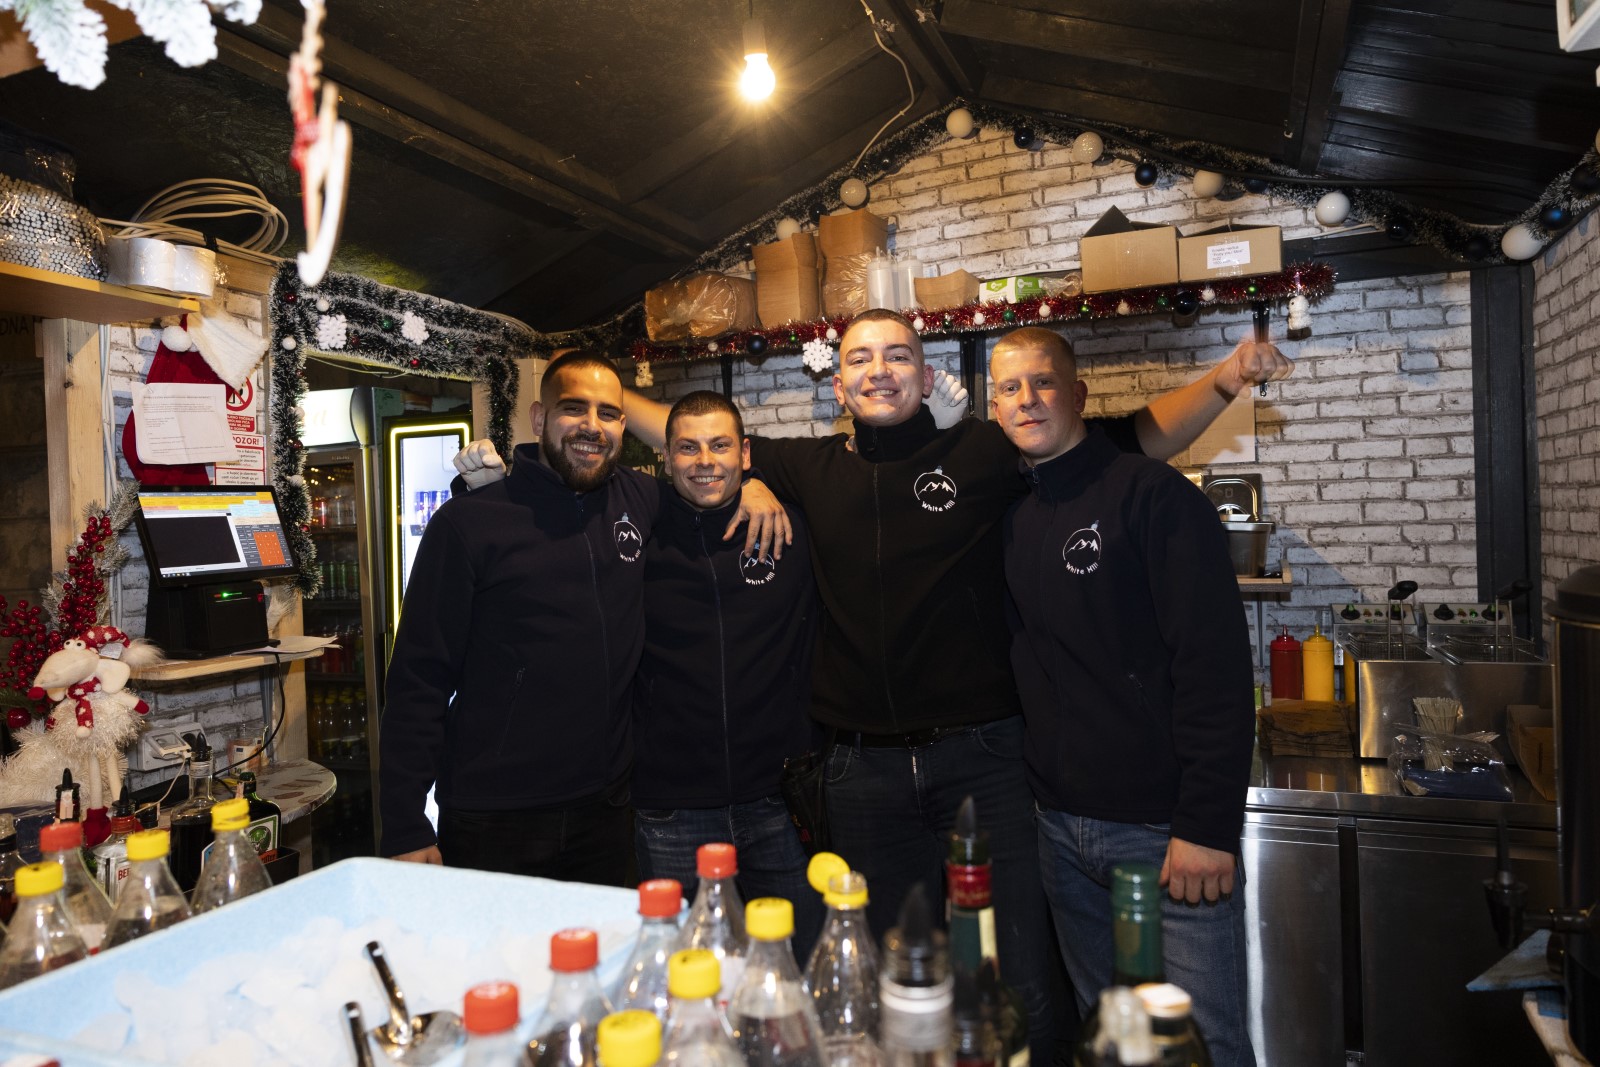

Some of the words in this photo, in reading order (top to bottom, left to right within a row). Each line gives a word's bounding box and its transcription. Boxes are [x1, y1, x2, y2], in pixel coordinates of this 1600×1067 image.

[233, 436, 259, 445] OZOR!
[922, 501, 943, 512] White
[1066, 562, 1085, 575] White
[745, 577, 765, 585] White
